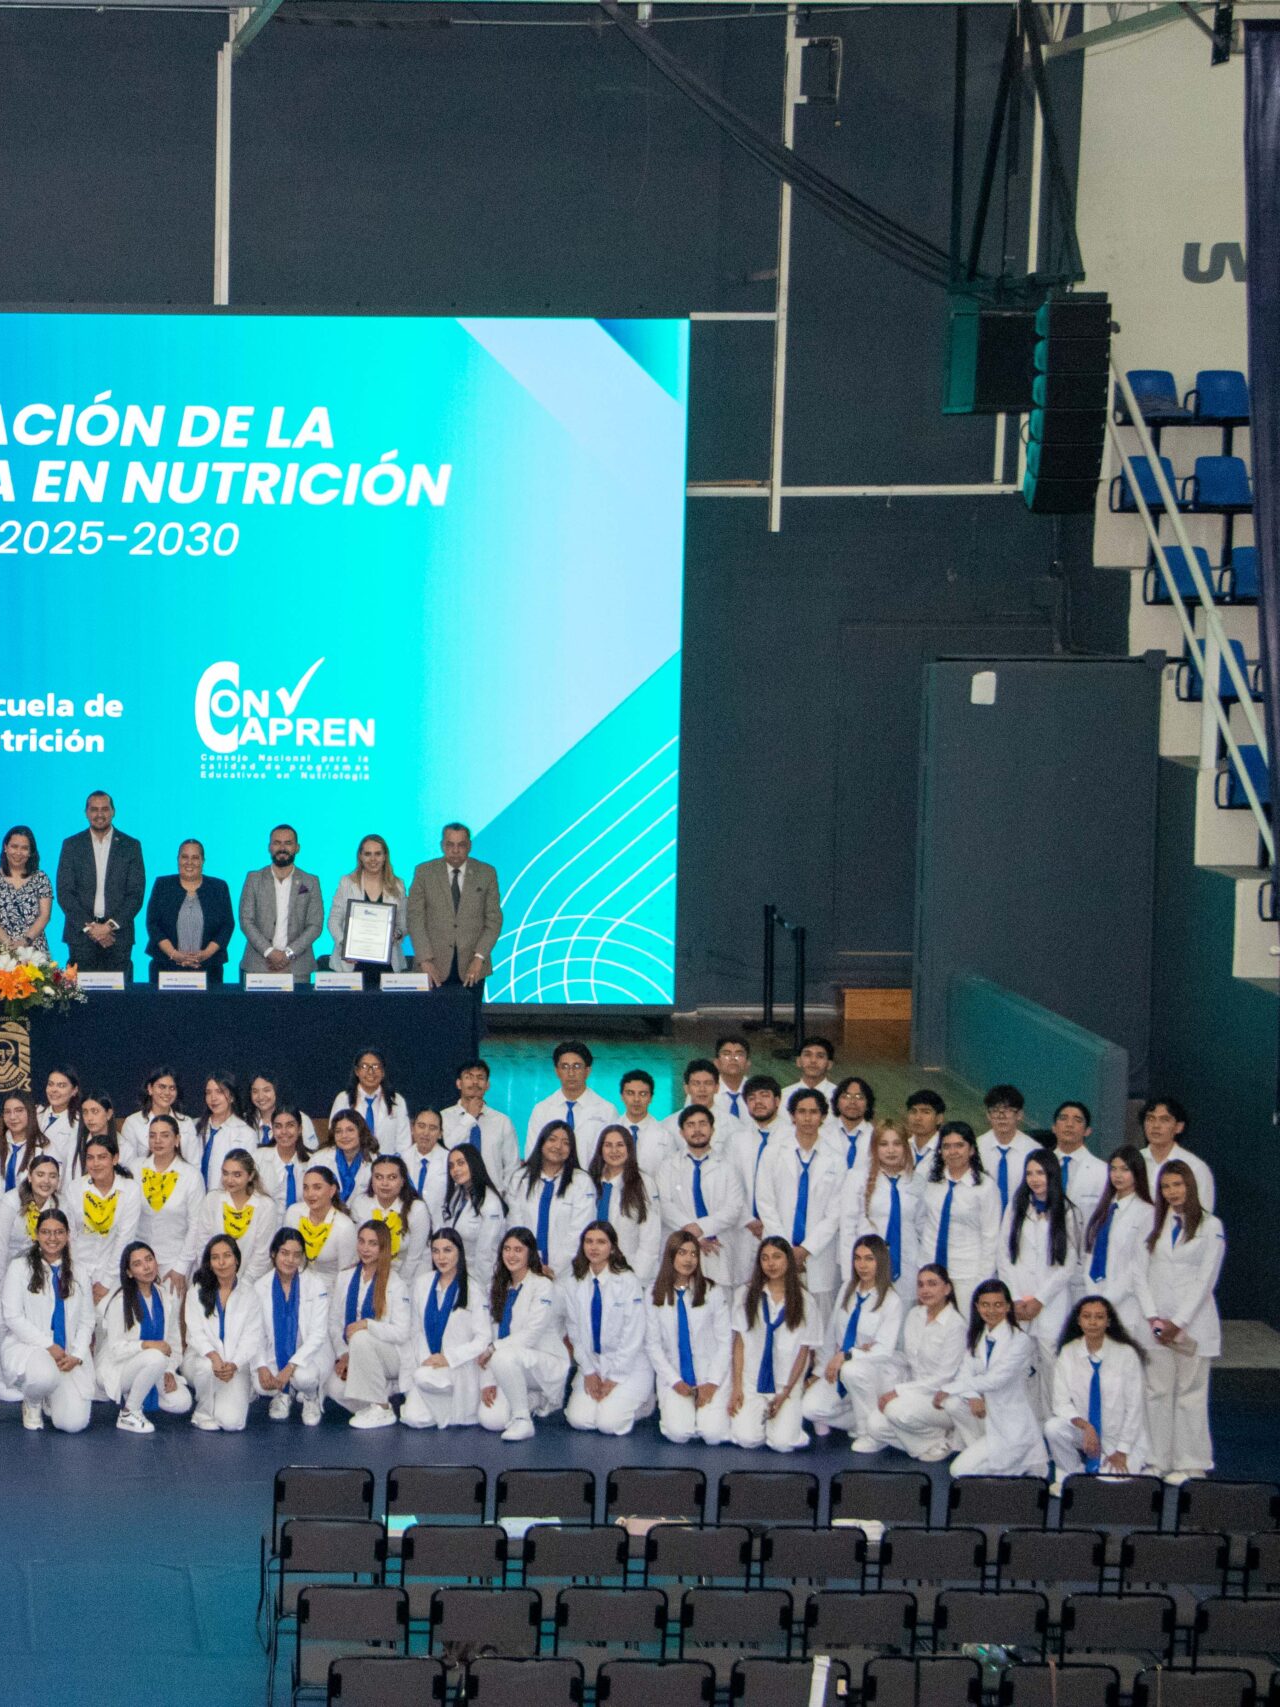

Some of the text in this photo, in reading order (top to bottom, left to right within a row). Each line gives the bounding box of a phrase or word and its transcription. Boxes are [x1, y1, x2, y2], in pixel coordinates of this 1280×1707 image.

[178, 405, 255, 448] DE
[266, 406, 334, 449] LA
[31, 460, 110, 503] EN
[121, 450, 453, 507] NUTRICIÓN
[84, 692, 124, 718] de
[200, 753, 249, 763] Consejo
[258, 754, 311, 763] Nacional
[265, 763, 281, 771] de
